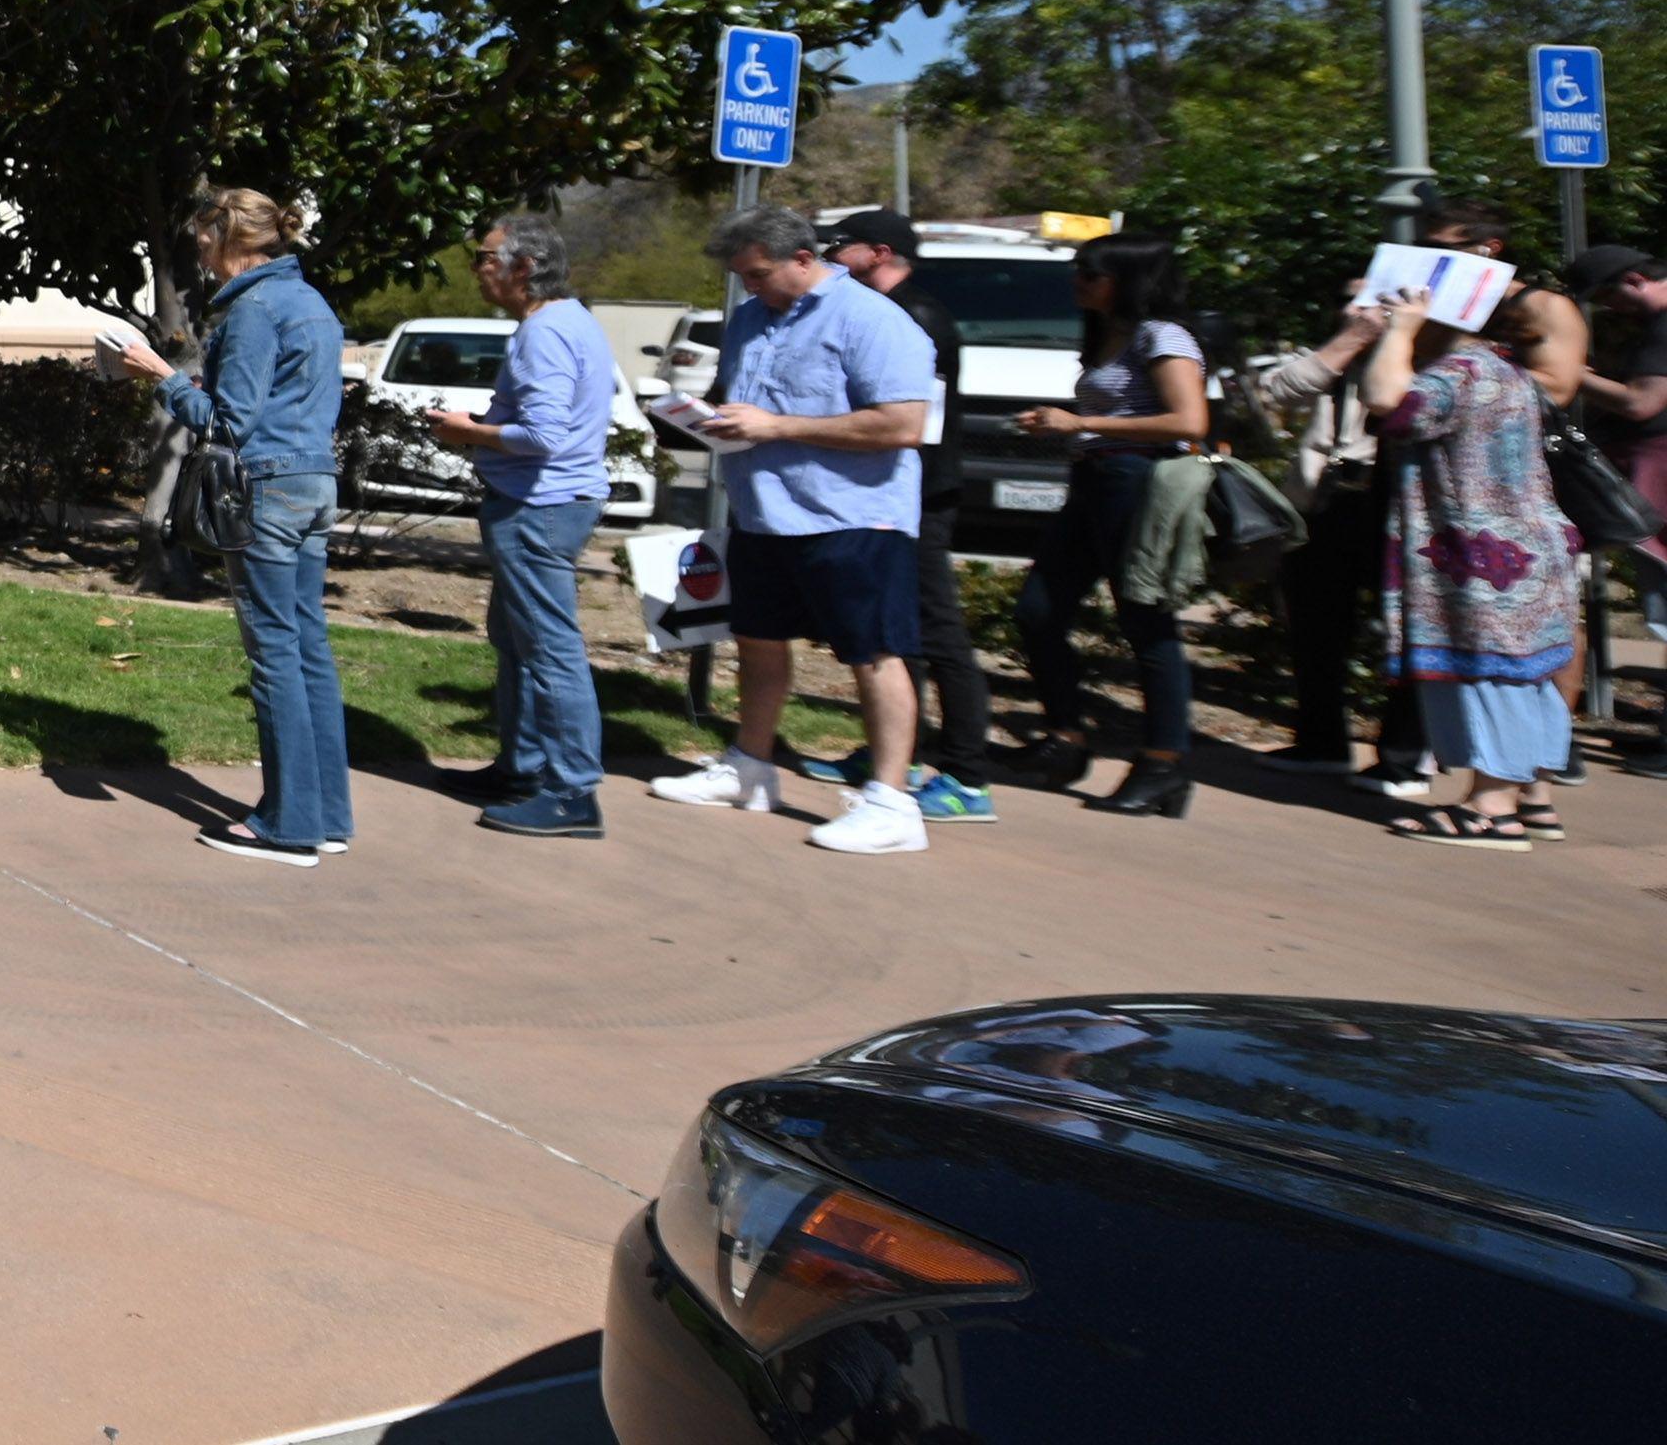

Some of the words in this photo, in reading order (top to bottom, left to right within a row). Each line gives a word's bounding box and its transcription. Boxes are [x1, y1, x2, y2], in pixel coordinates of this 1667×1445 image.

[725, 99, 790, 127] PARKING
[1544, 111, 1602, 131] PARKING
[736, 128, 776, 151] ONLY
[1558, 136, 1590, 153] ONLY
